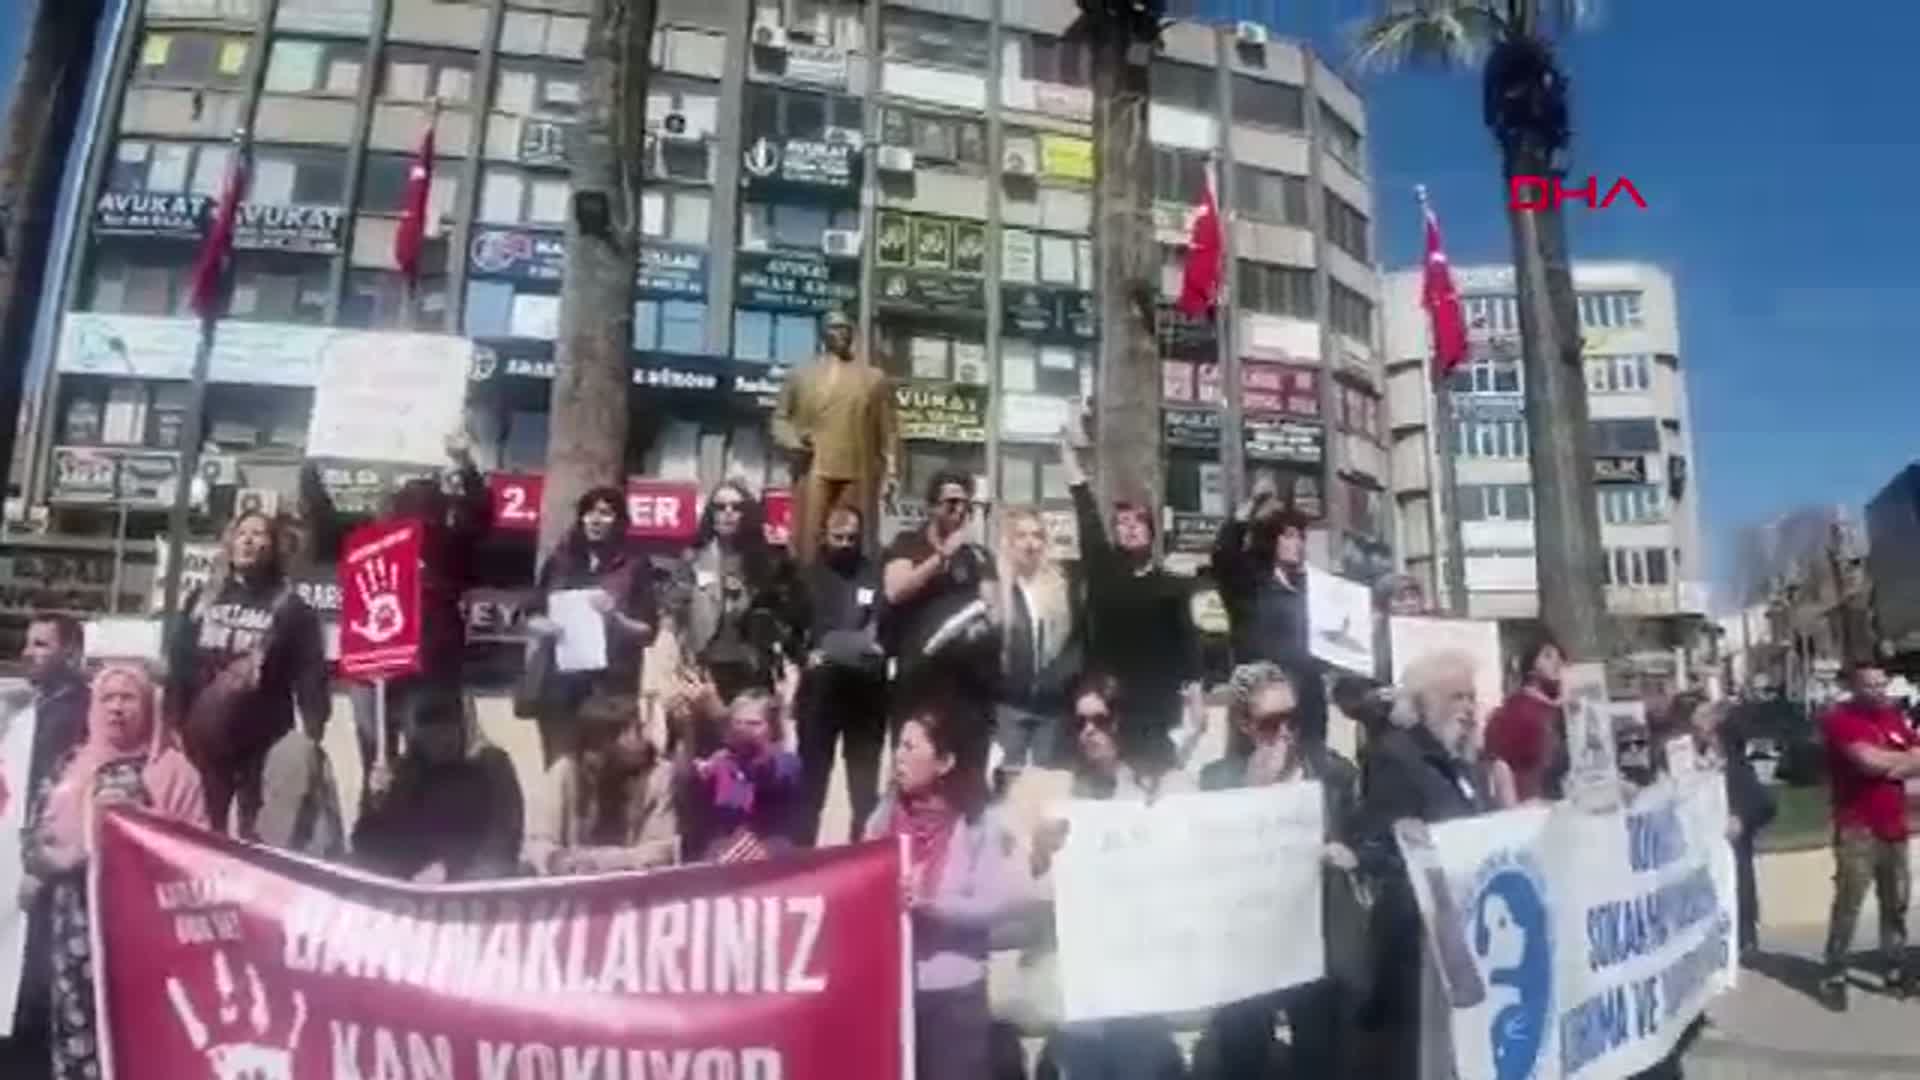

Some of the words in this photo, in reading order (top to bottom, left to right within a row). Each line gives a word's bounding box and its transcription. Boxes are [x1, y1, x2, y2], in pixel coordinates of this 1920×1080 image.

[98, 192, 207, 216] AVUKAT
[896, 389, 977, 412] VUKAT
[501, 487, 537, 520] 2.
[627, 493, 681, 527] ER
[329, 1019, 454, 1079] KAN
